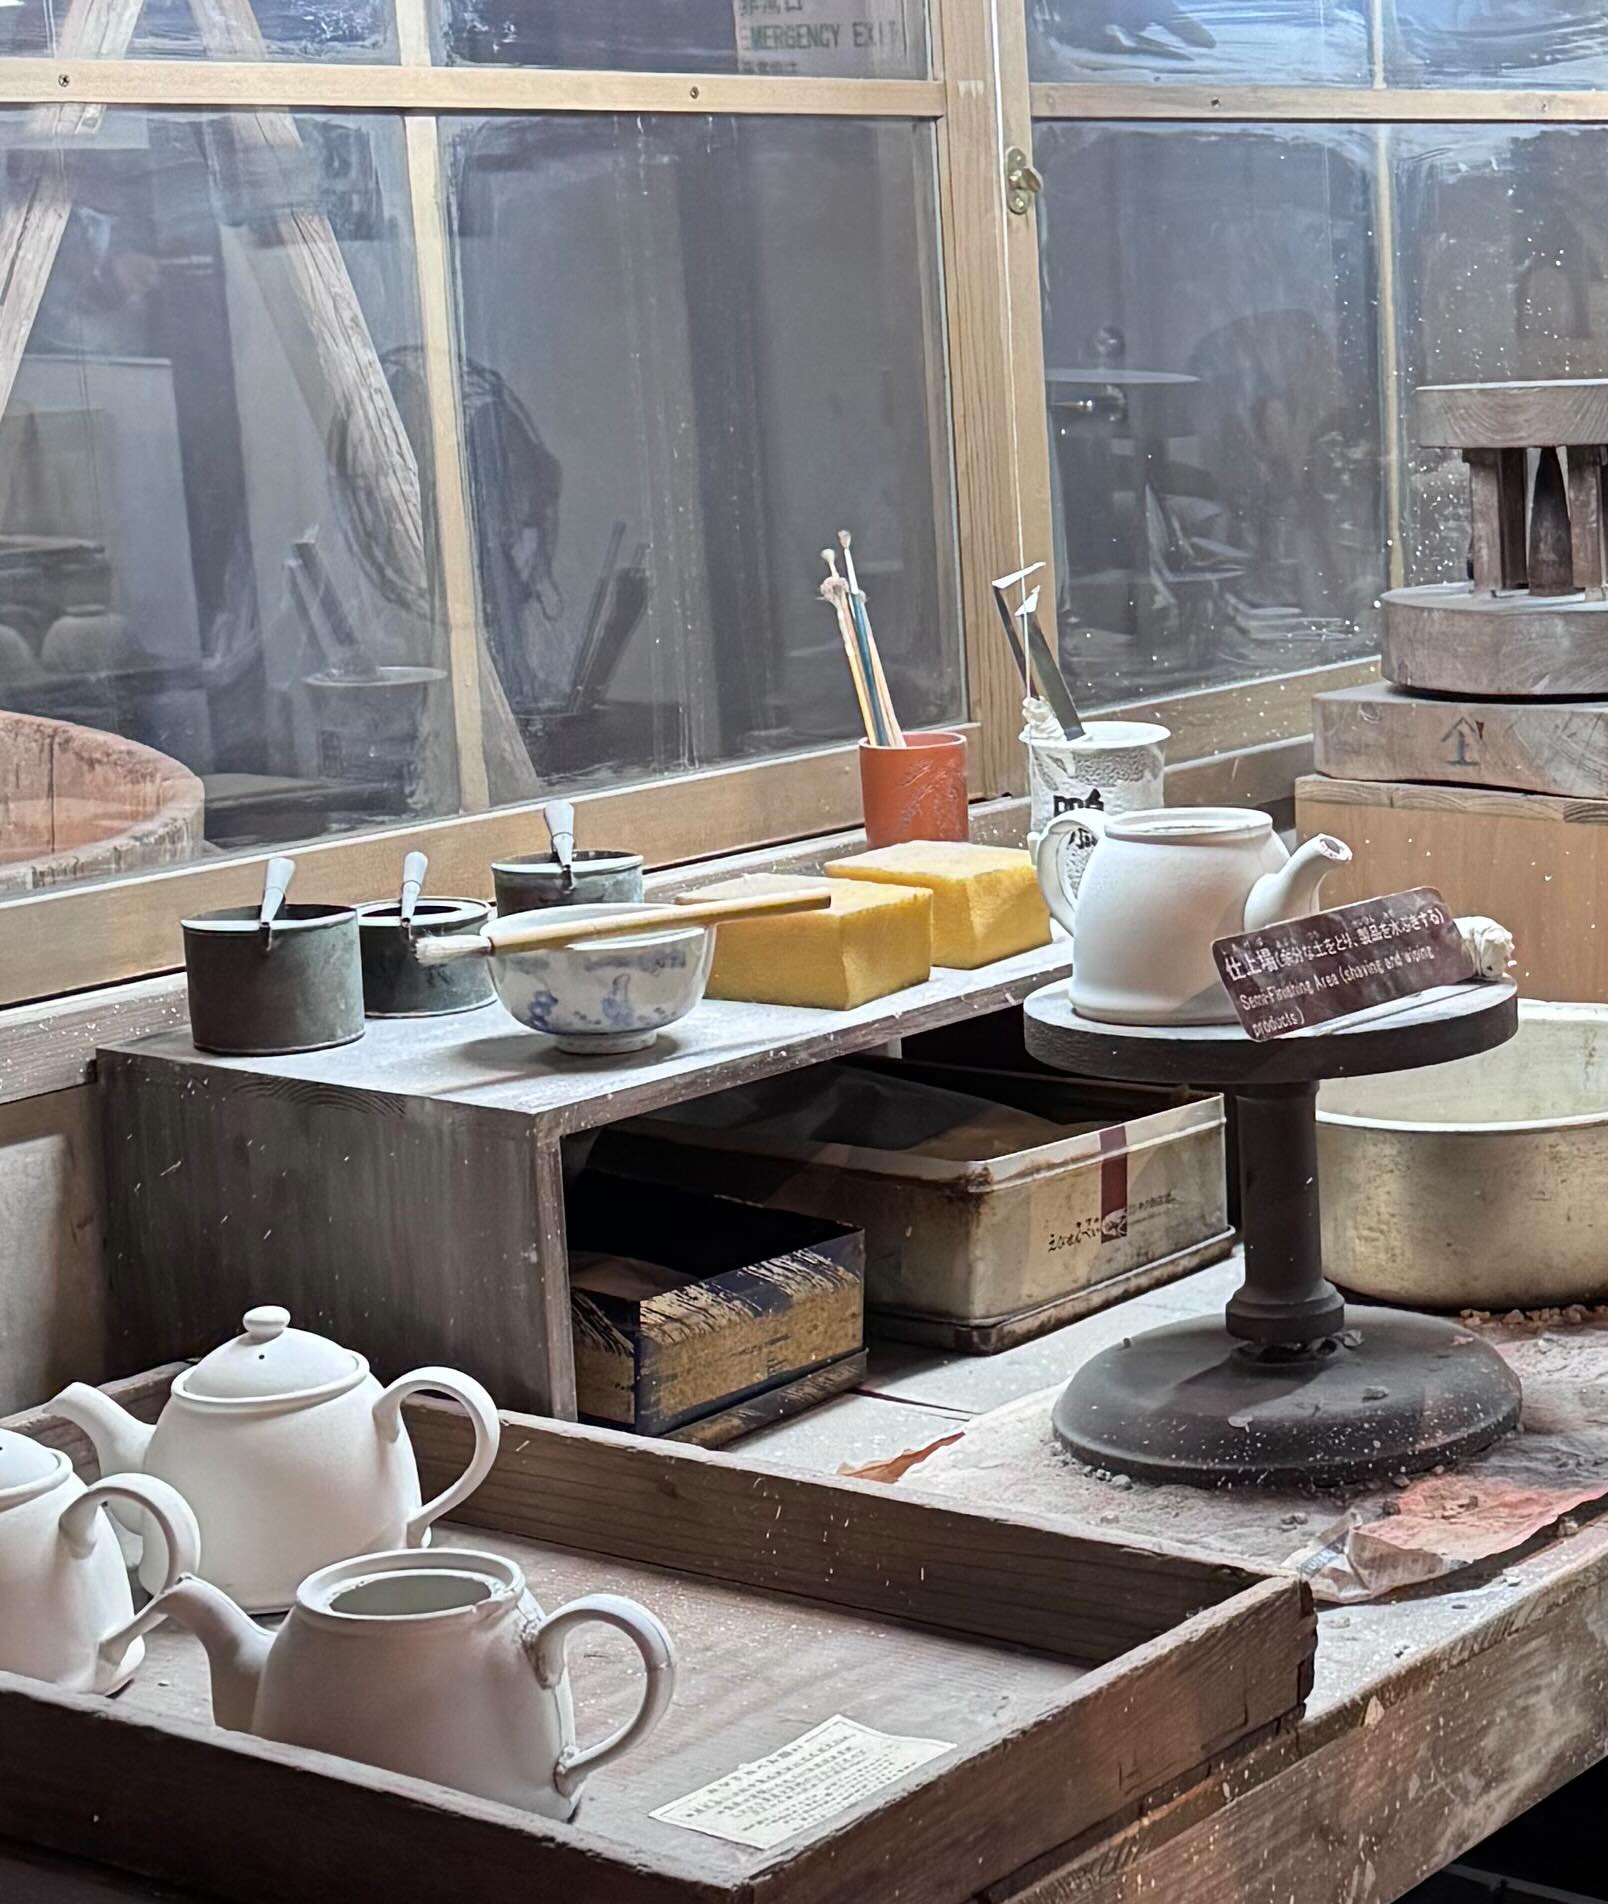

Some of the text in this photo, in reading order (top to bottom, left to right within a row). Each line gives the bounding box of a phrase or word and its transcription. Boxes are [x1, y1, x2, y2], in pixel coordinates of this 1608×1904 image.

[740, 23, 840, 49] EMERGENCY
[1314, 972, 1340, 993] Area
[1384, 949, 1403, 970] and
